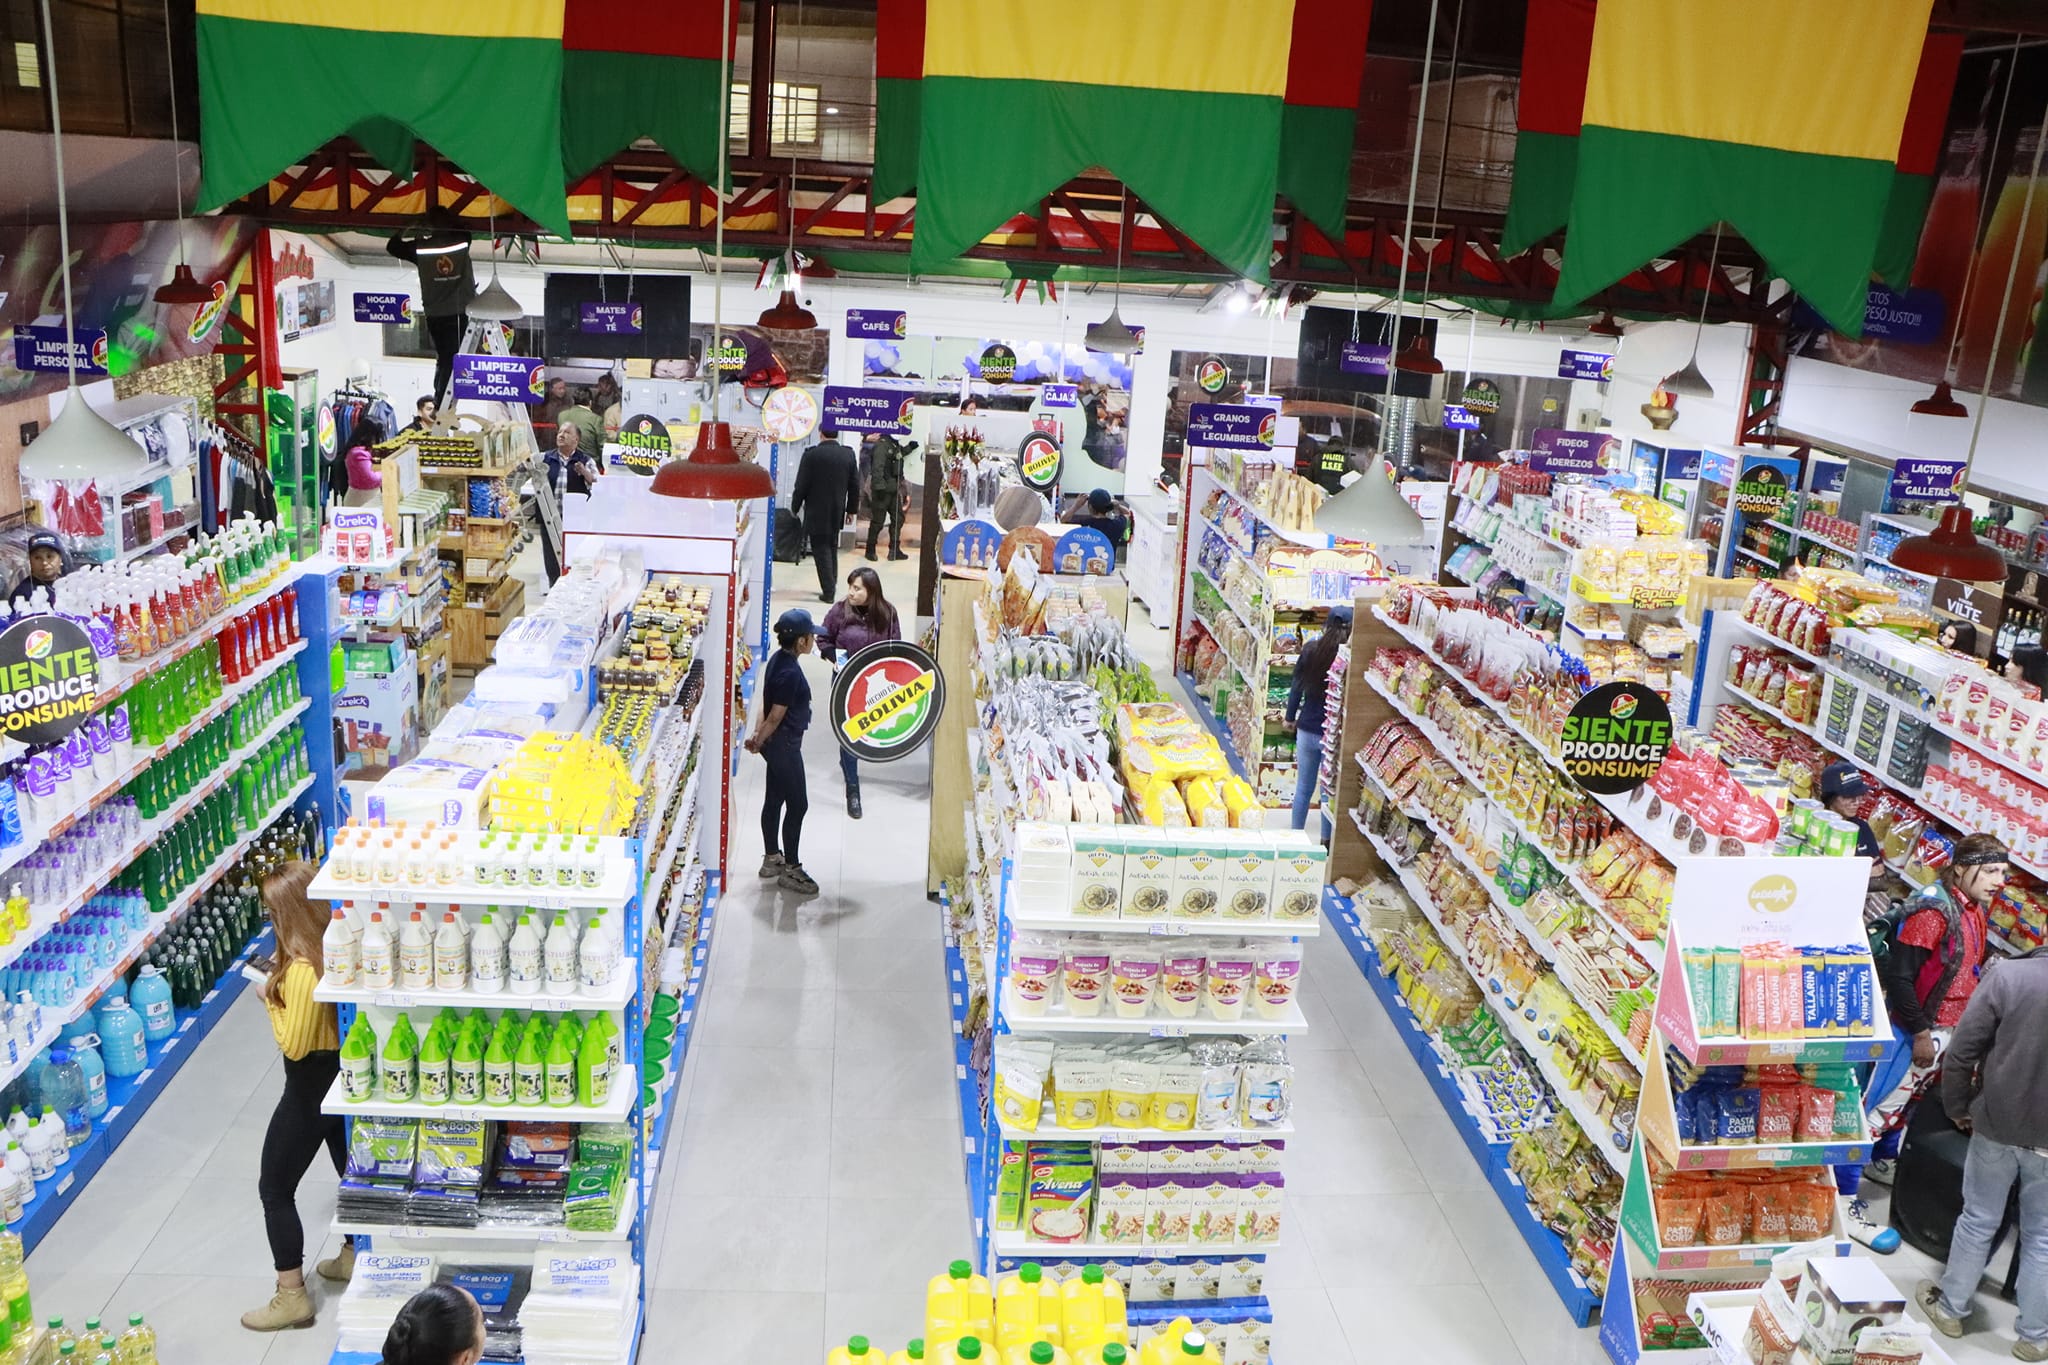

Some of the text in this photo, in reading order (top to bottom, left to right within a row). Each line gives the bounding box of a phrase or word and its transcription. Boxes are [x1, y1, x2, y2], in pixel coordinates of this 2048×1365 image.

[367, 296, 397, 305] HOGAR
[378, 305, 385, 313] Y
[596, 306, 627, 315] MATES
[370, 313, 395, 322] MODA
[607, 315, 614, 323] Y
[605, 322, 617, 332] TÉ
[862, 320, 890, 332] CAFÉS
[1348, 354, 1386, 366] CHOCOLATES
[471, 361, 527, 374] LIMPIEZA
[1586, 362, 1592, 370] Y
[487, 374, 510, 385] DEL
[478, 385, 519, 397] HOGAR
[1045, 392, 1076, 402] CAJA 3
[848, 397, 889, 409] POSTRES
[864, 409, 872, 418] Y
[1213, 413, 1250, 424] GRANOS
[1450, 413, 1474, 425] CAJA
[835, 416, 899, 431] MERMELADAS
[1226, 424, 1233, 432] Y
[1203, 432, 1257, 444] LEGUMBRES
[1556, 438, 1589, 449] FIDEOS
[1568, 449, 1575, 457] Y
[1027, 454, 1057, 475] BOLIVIA
[1545, 457, 1594, 470] ADEREZOS
[1911, 463, 1953, 475] LACTEOS
[1927, 475, 1934, 485] Y
[1905, 485, 1950, 497] GALLETAS
[1947, 598, 1983, 624] VILTE
[866, 683, 898, 706] HECHO EN
[857, 681, 926, 731] BOLIVIA
[1561, 740, 1667, 763] PRODUCE,
[1564, 758, 1659, 779] CONSUME
[1757, 974, 1765, 1024] LINGUINI
[1771, 975, 1782, 1024] LINGUINI
[1789, 972, 1799, 1022] LINGUINI
[1806, 970, 1817, 1022] TALLARIN
[1836, 970, 1846, 1021] TALLARIN
[1860, 969, 1869, 1020] TALLARIN
[1728, 1117, 1755, 1126] PASTA
[1763, 1116, 1789, 1125] PASTA
[1727, 1125, 1756, 1134] CORTA
[1762, 1123, 1791, 1133] CORTA
[1037, 1178, 1083, 1191] Avena
[1761, 1214, 1786, 1224] PASTA
[1789, 1214, 1818, 1226] PASTA
[1667, 1226, 1693, 1234] PASTA
[1716, 1223, 1741, 1233] PASTA
[1760, 1222, 1787, 1232] CORTA
[1664, 1232, 1694, 1242] CORTA
[1715, 1231, 1741, 1241] CORTA
